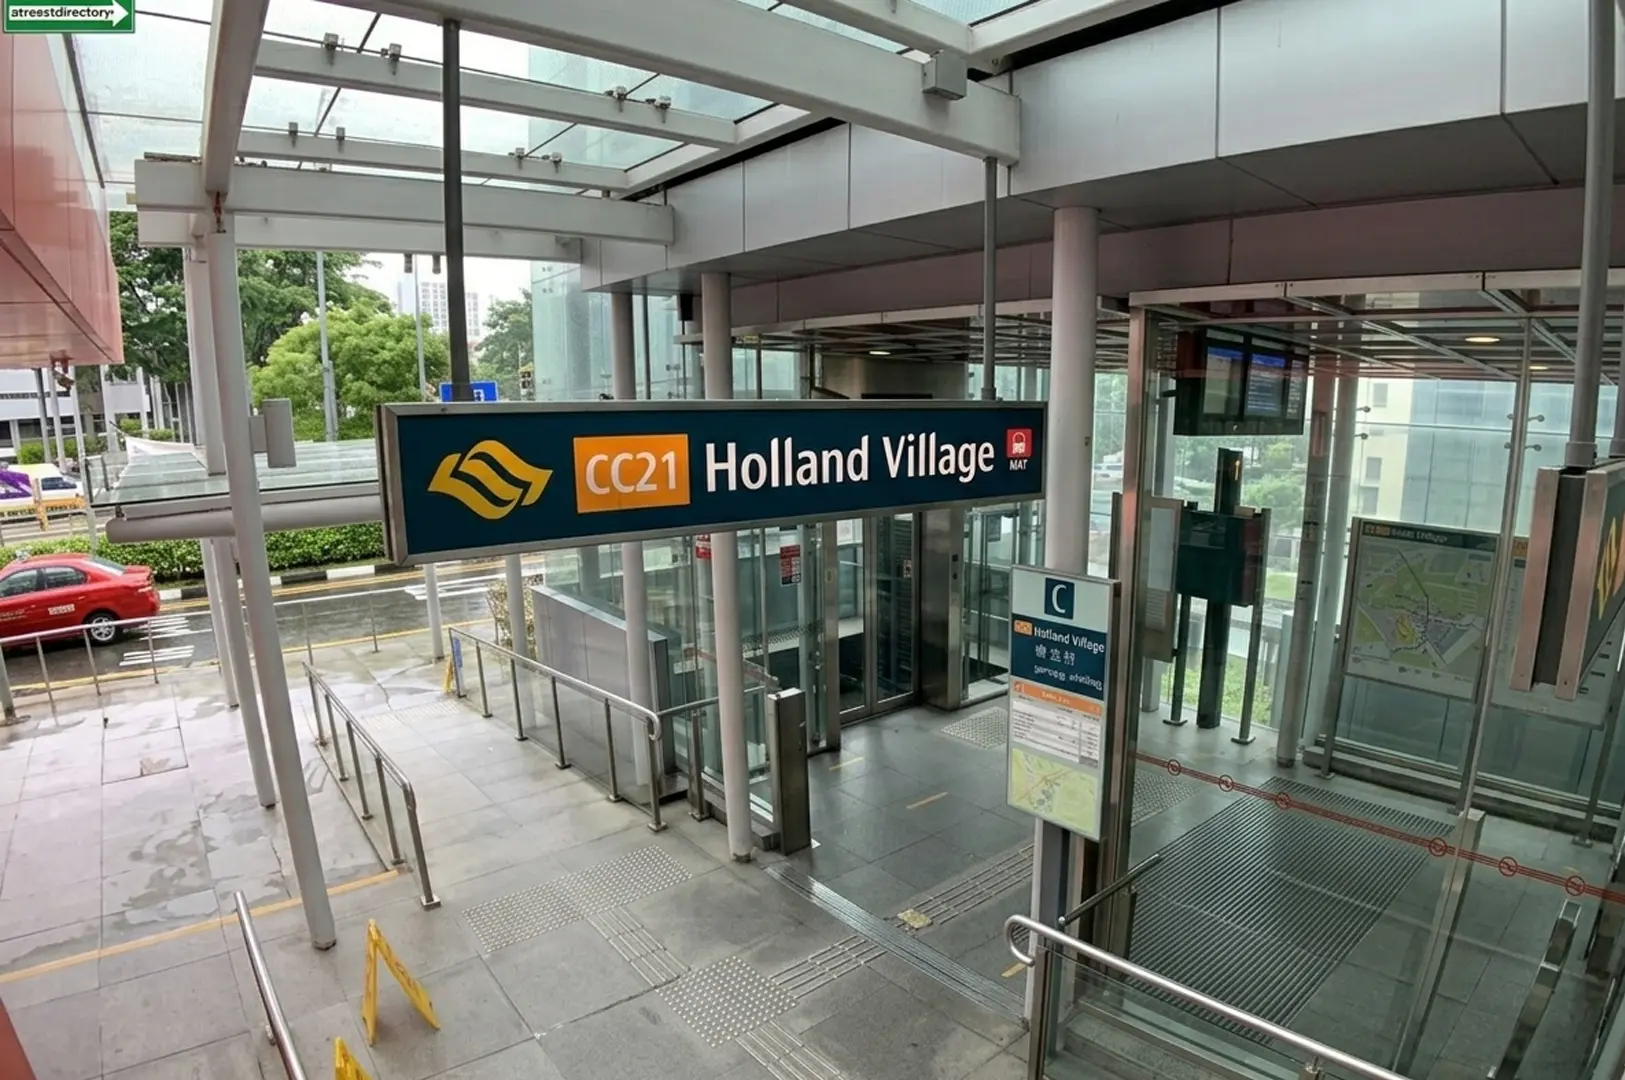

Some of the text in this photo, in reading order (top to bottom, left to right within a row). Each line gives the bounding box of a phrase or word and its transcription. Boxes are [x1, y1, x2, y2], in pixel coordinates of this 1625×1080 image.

[585, 432, 995, 495] CC21 Holland Village
[1052, 584, 1067, 614] C
